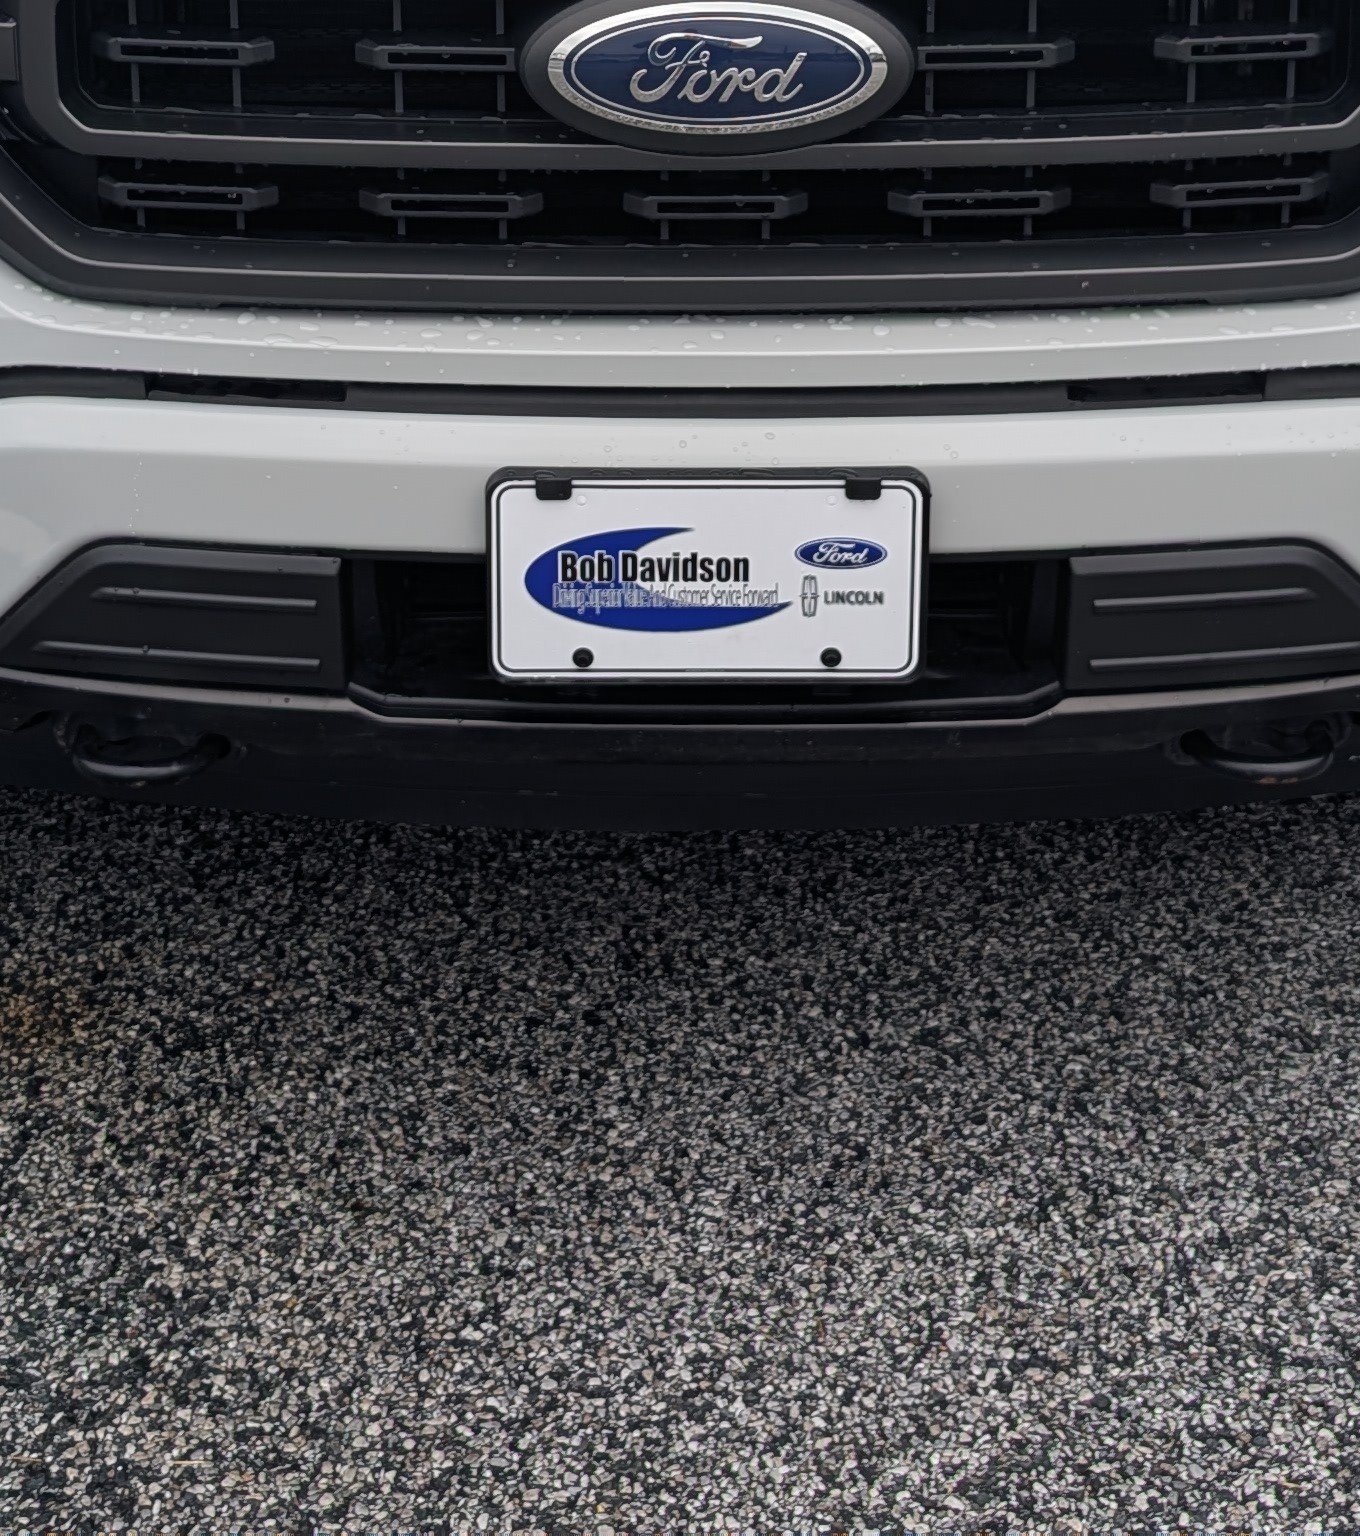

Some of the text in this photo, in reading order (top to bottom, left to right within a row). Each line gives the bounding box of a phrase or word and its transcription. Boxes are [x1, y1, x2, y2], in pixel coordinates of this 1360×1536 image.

[629, 31, 808, 103] Ford
[812, 541, 870, 564] Ford
[560, 551, 750, 583] Bob Davidson
[823, 590, 885, 605] LINCOLN
